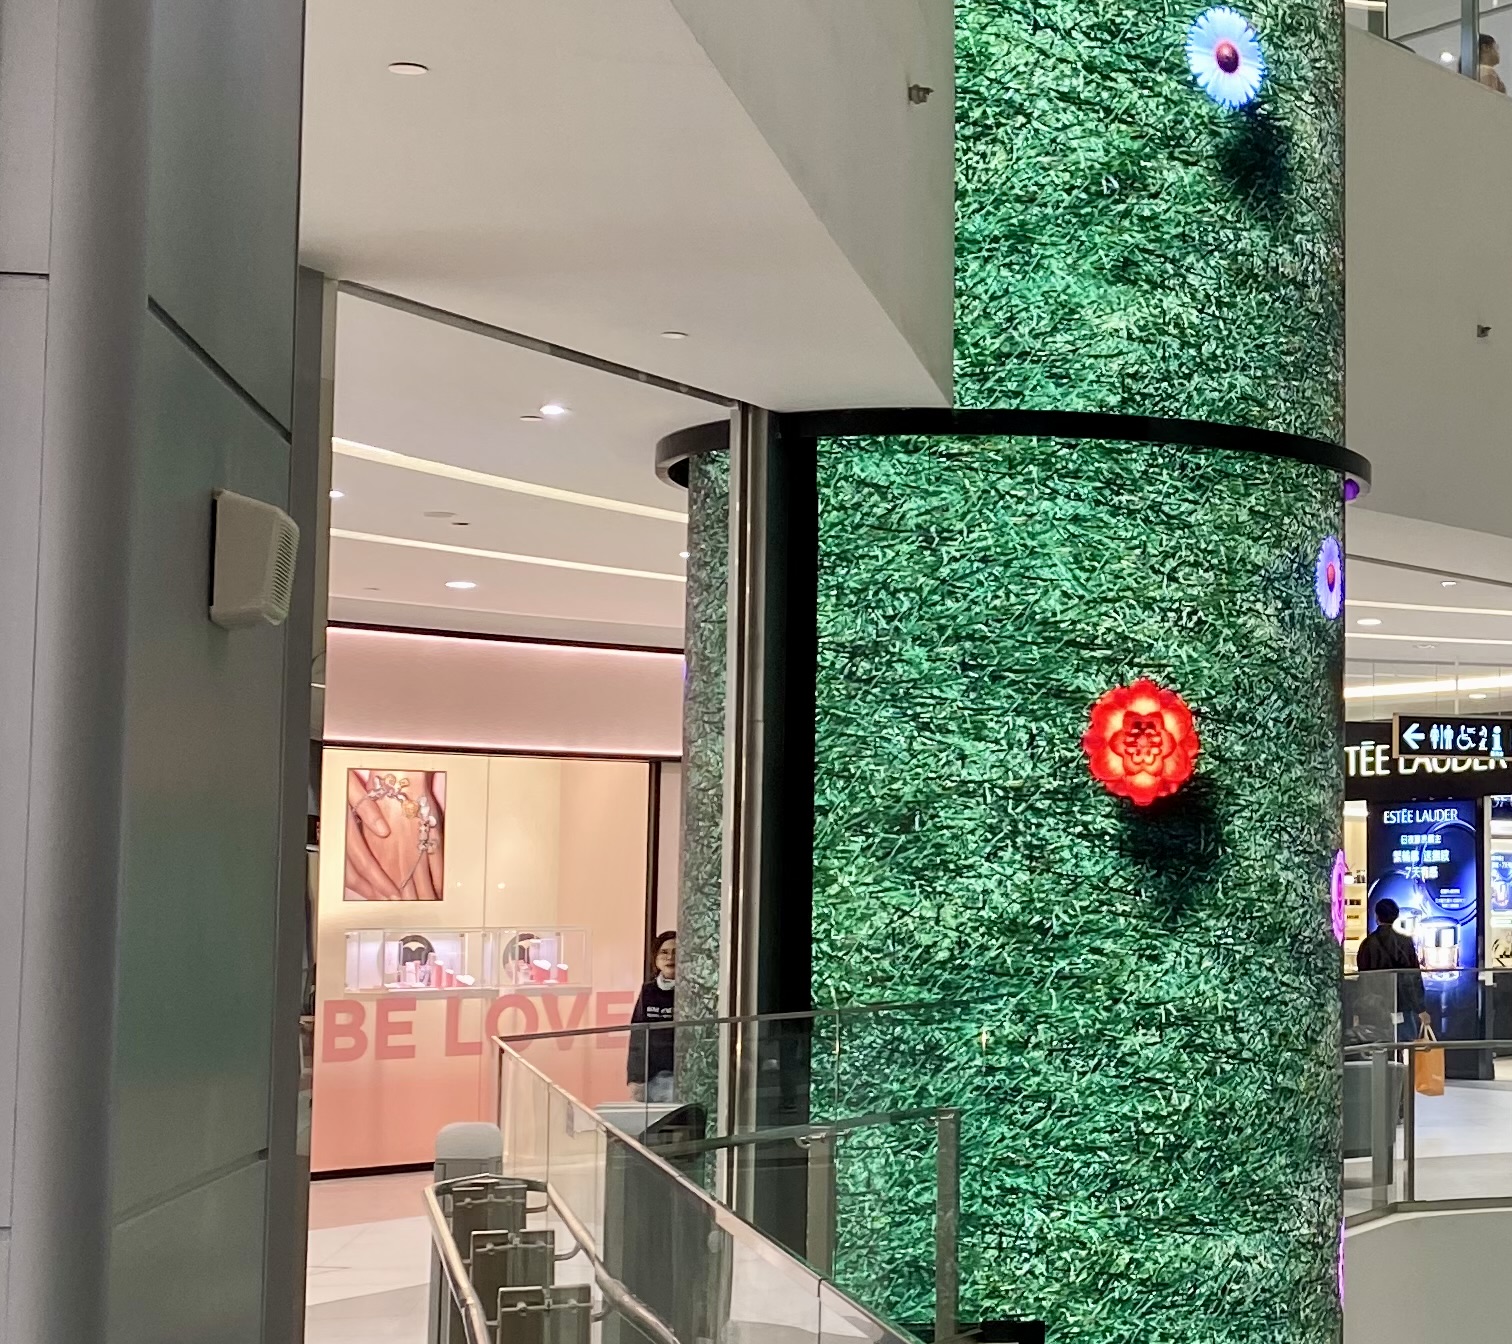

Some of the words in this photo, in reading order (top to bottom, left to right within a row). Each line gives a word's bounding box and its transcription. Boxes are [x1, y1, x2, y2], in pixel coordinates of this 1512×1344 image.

[1416, 808, 1458, 823] LAUDER
[322, 998, 417, 1063] BE
[444, 991, 635, 1057] LOVE
